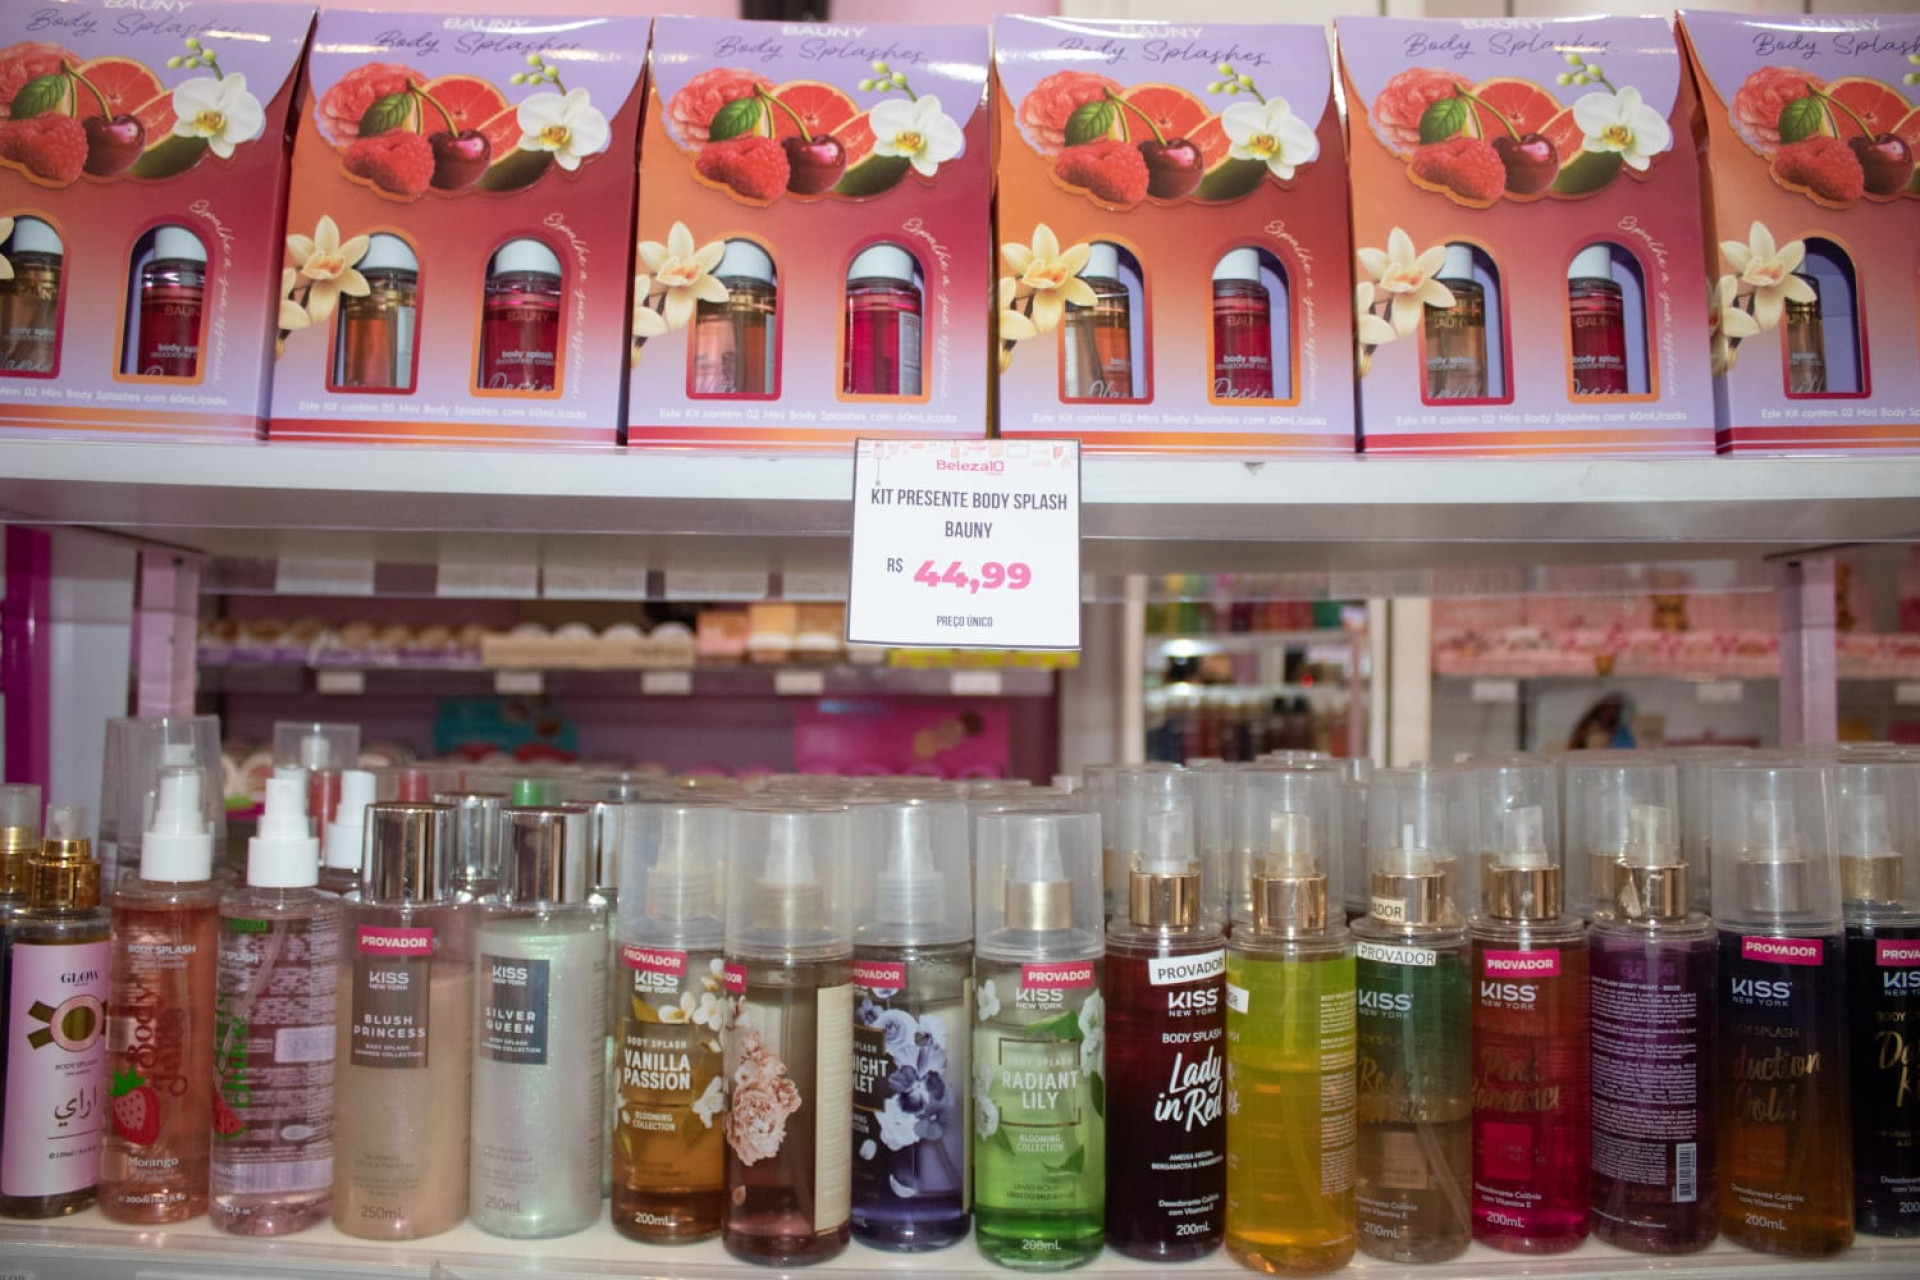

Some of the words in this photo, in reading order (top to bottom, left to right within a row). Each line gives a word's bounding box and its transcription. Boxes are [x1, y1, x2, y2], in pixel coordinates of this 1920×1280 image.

[26, 9, 97, 36] Body
[442, 17, 529, 31] BAUNY
[780, 25, 867, 38] BAUNY
[374, 31, 440, 56] Body
[453, 32, 582, 57] Splashes
[713, 35, 784, 62] Body
[798, 38, 928, 64] Splashes
[1403, 32, 1475, 59] Body
[1487, 32, 1618, 57] Splashes
[1752, 32, 1822, 60] Body
[1142, 40, 1272, 66] Splashes
[871, 488, 894, 505] KIT
[897, 489, 969, 508] PRESENTE
[973, 492, 1010, 509] BODY
[1013, 493, 1067, 511] SPLASH
[944, 521, 993, 539] BAUNY
[886, 557, 904, 573] R$
[913, 560, 1032, 594] 44,99
[936, 615, 965, 629] PREÇO
[967, 613, 993, 628] ÚNICO
[155, 944, 197, 955] SPLASH
[362, 936, 428, 948] PROVADOR
[1746, 942, 1816, 957] PROVADOR
[624, 948, 682, 968] PROVADOR
[1361, 945, 1434, 966] PROVADOR
[1157, 957, 1222, 981] PROVADOR
[1487, 958, 1554, 970] PROVADOR
[369, 971, 410, 984] KISS
[492, 965, 528, 980] KISS
[635, 970, 678, 987] KISS
[1028, 970, 1091, 982] PROVADOR
[635, 984, 652, 992] NEW
[654, 986, 678, 994] YORK
[1015, 988, 1064, 1002] KISS
[1480, 980, 1537, 1002] KISS
[1731, 977, 1792, 999] KISS
[1884, 989, 1908, 997] NEW
[1015, 1002, 1035, 1010] NEW
[1038, 1002, 1062, 1010] YORK
[1168, 988, 1218, 1009] KISS
[1358, 989, 1412, 1011] KISS
[1481, 1000, 1506, 1010] NEW
[1507, 1002, 1535, 1011] YORK
[1732, 997, 1753, 1006] NEW
[1759, 998, 1788, 1007] YORK
[364, 1014, 413, 1025] BLUSH
[485, 1006, 536, 1021] SILVER
[1168, 1009, 1191, 1017] NEW
[1195, 1007, 1217, 1016] YORK
[1359, 1007, 1377, 1016] NEW
[1382, 1011, 1409, 1019] YORK
[354, 1025, 426, 1039] PRINCESS
[485, 1020, 534, 1034] QUEEN
[627, 1035, 647, 1047] BODY
[650, 1040, 687, 1048] SPLASH
[1162, 1032, 1191, 1044] BODY
[1192, 1030, 1222, 1043] SPLASH
[624, 1049, 690, 1072] VANILLA
[1169, 1046, 1222, 1094] Lady
[624, 1069, 690, 1090] PASSION
[1002, 1070, 1079, 1089] RADIANT
[1022, 1090, 1059, 1110] LILY
[634, 1110, 672, 1122] BLOOMING
[1154, 1093, 1183, 1122] in
[1185, 1087, 1222, 1133] Red
[632, 1120, 676, 1132] COLLECTION
[1020, 1134, 1061, 1143] BLOOMING
[1017, 1143, 1064, 1152] COLLECTION
[128, 1157, 179, 1168] Morango
[484, 1197, 525, 1214] 250mL
[1495, 1196, 1525, 1208] Vitamina
[1900, 1202, 1920, 1215] 200
[360, 1205, 406, 1220] 250mL
[635, 1212, 675, 1226] 200mL
[1486, 1211, 1525, 1228] 200mL
[1176, 1221, 1211, 1235] 200mL
[1745, 1213, 1787, 1230] 200mL
[1364, 1222, 1400, 1238] 200mL
[1022, 1238, 1061, 1251] 200mL
